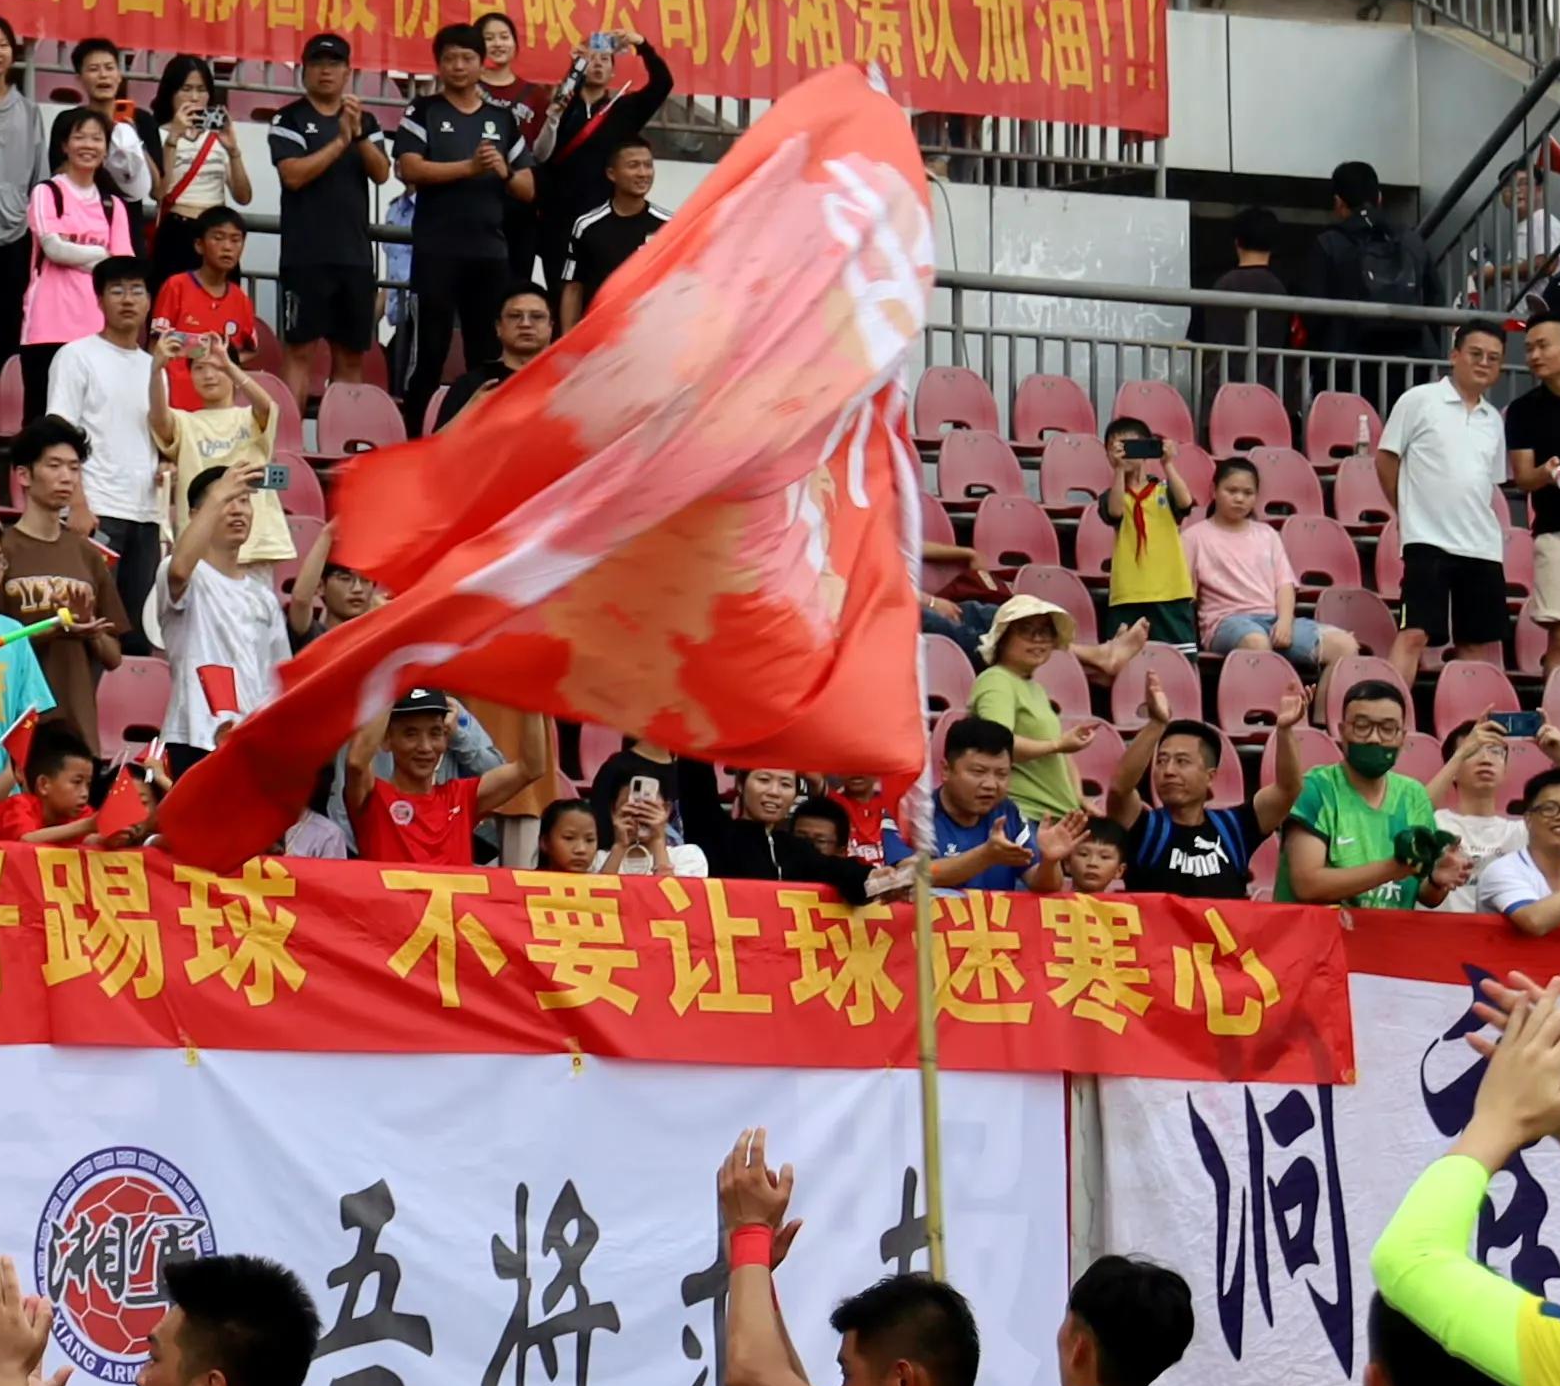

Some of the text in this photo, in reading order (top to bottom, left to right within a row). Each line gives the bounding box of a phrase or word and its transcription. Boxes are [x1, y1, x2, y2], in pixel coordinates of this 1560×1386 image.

[383, 867, 1284, 1037] 不要让球迷寒心
